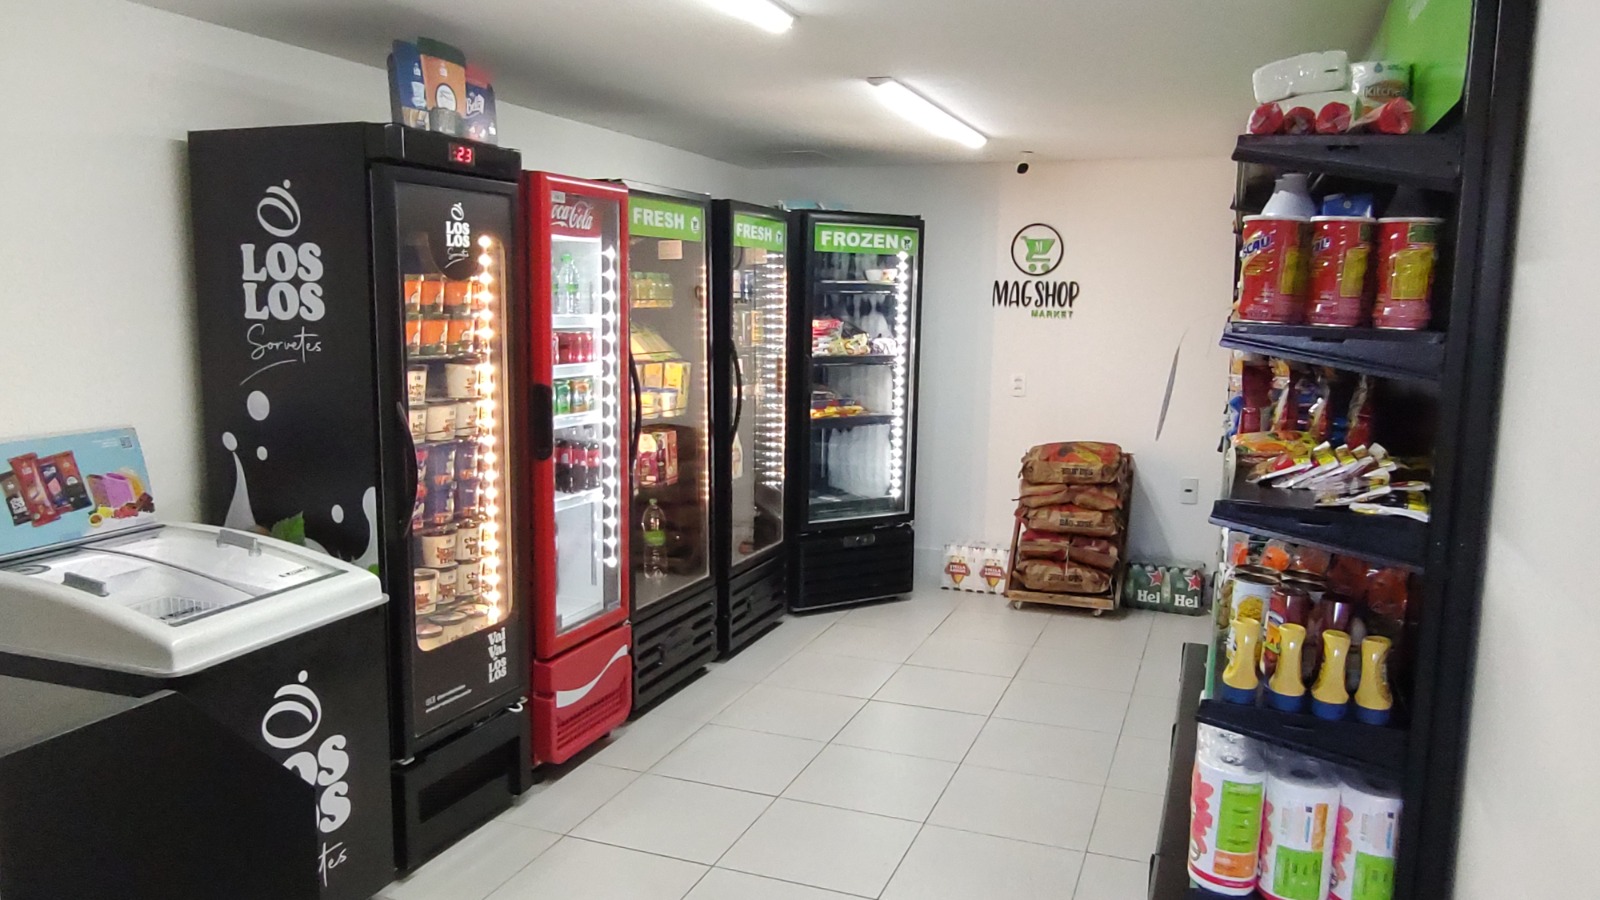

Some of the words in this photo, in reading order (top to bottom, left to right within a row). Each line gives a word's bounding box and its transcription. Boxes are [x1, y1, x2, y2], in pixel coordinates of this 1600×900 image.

[633, 207, 685, 230] FRESH
[446, 221, 470, 235] LOS
[736, 223, 772, 242] FRESH
[446, 235, 470, 248] LOS
[821, 231, 899, 249] FROZEN
[240, 242, 323, 281] LOS
[244, 282, 325, 321] LOS
[1031, 309, 1073, 319] MARKET
[247, 323, 321, 363] Sorvetes
[1174, 594, 1198, 608] Hei
[488, 657, 507, 674] LOS
[488, 667, 507, 683] LOS
